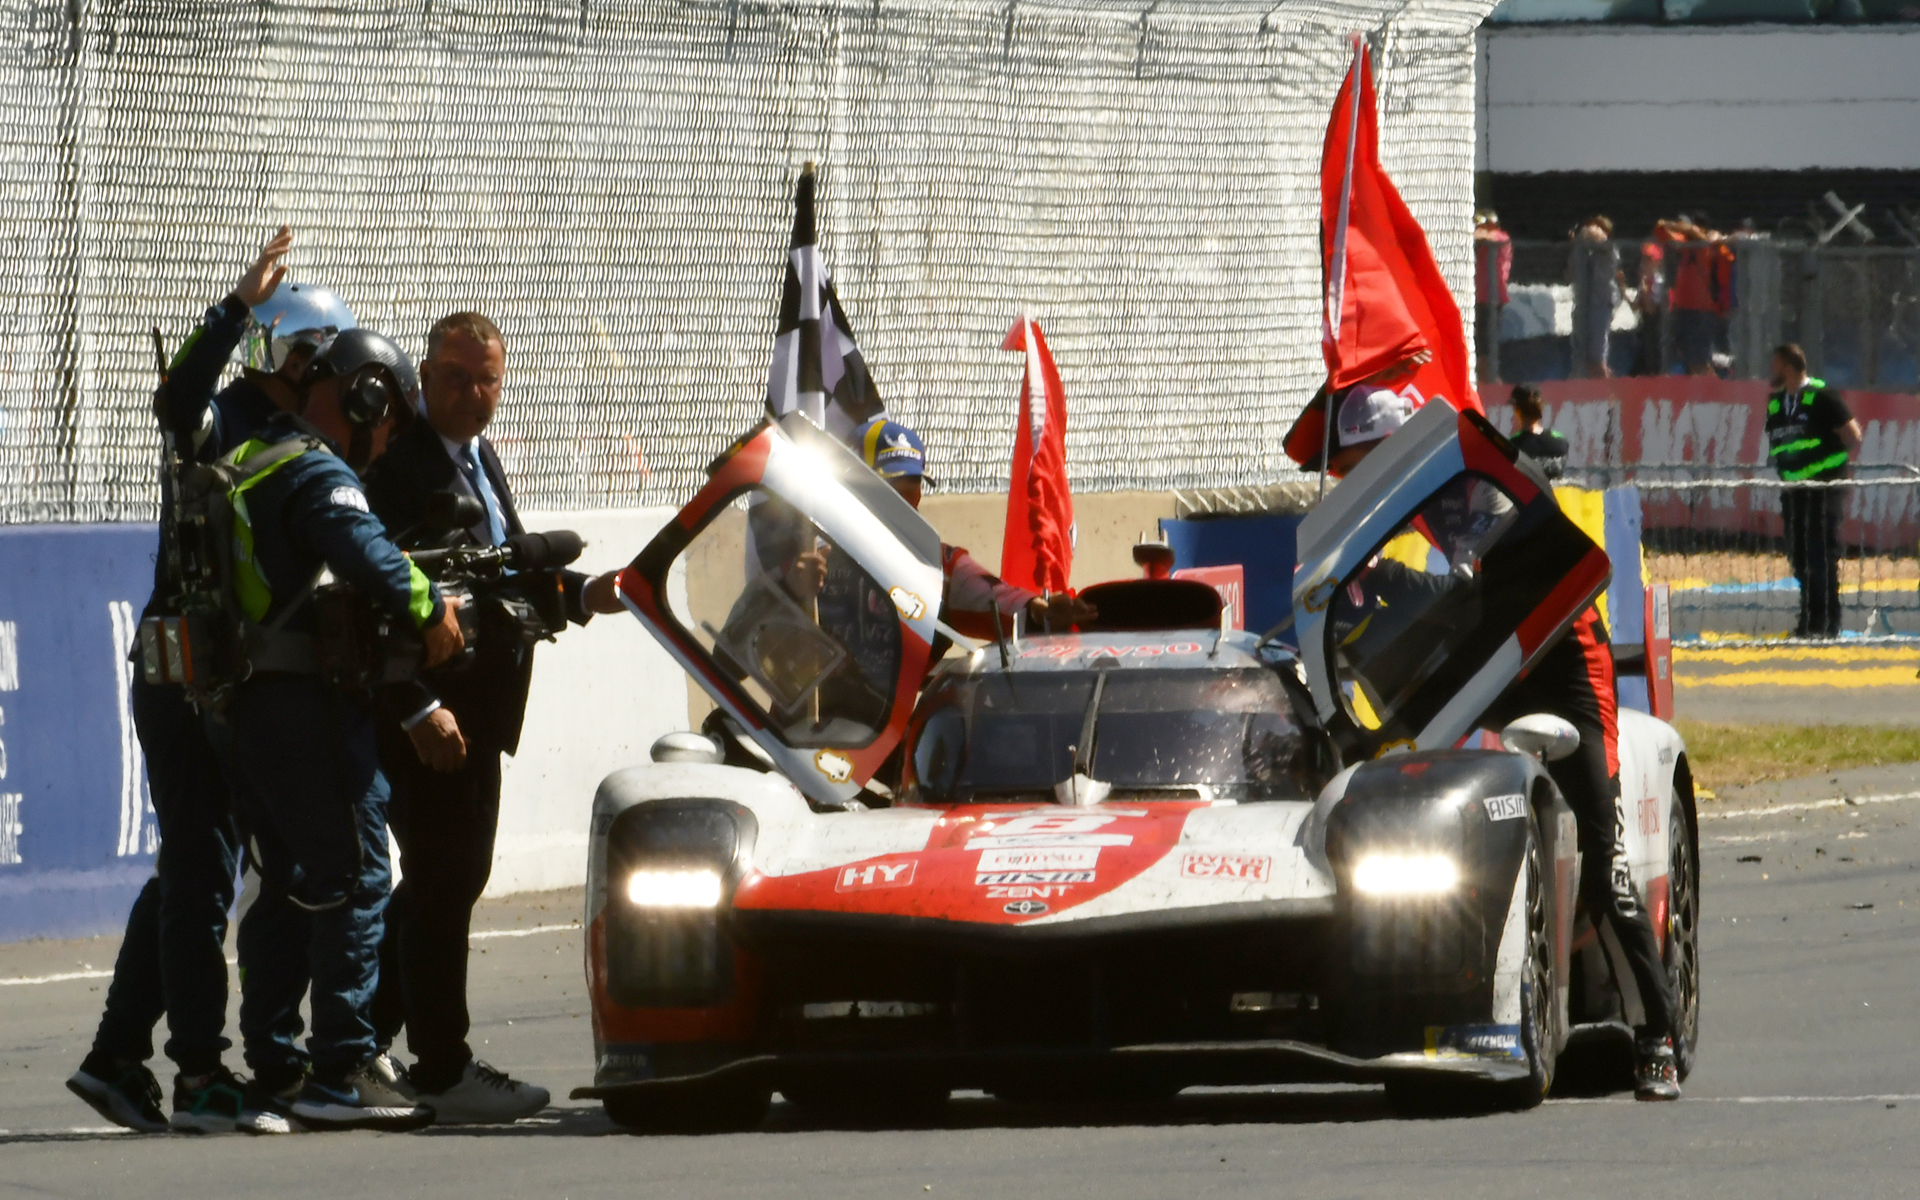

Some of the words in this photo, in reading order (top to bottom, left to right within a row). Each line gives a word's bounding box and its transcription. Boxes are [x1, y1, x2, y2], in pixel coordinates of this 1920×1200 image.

[843, 863, 909, 886] HY
[1188, 863, 1262, 878] CAR
[986, 885, 1074, 899] ZENT
